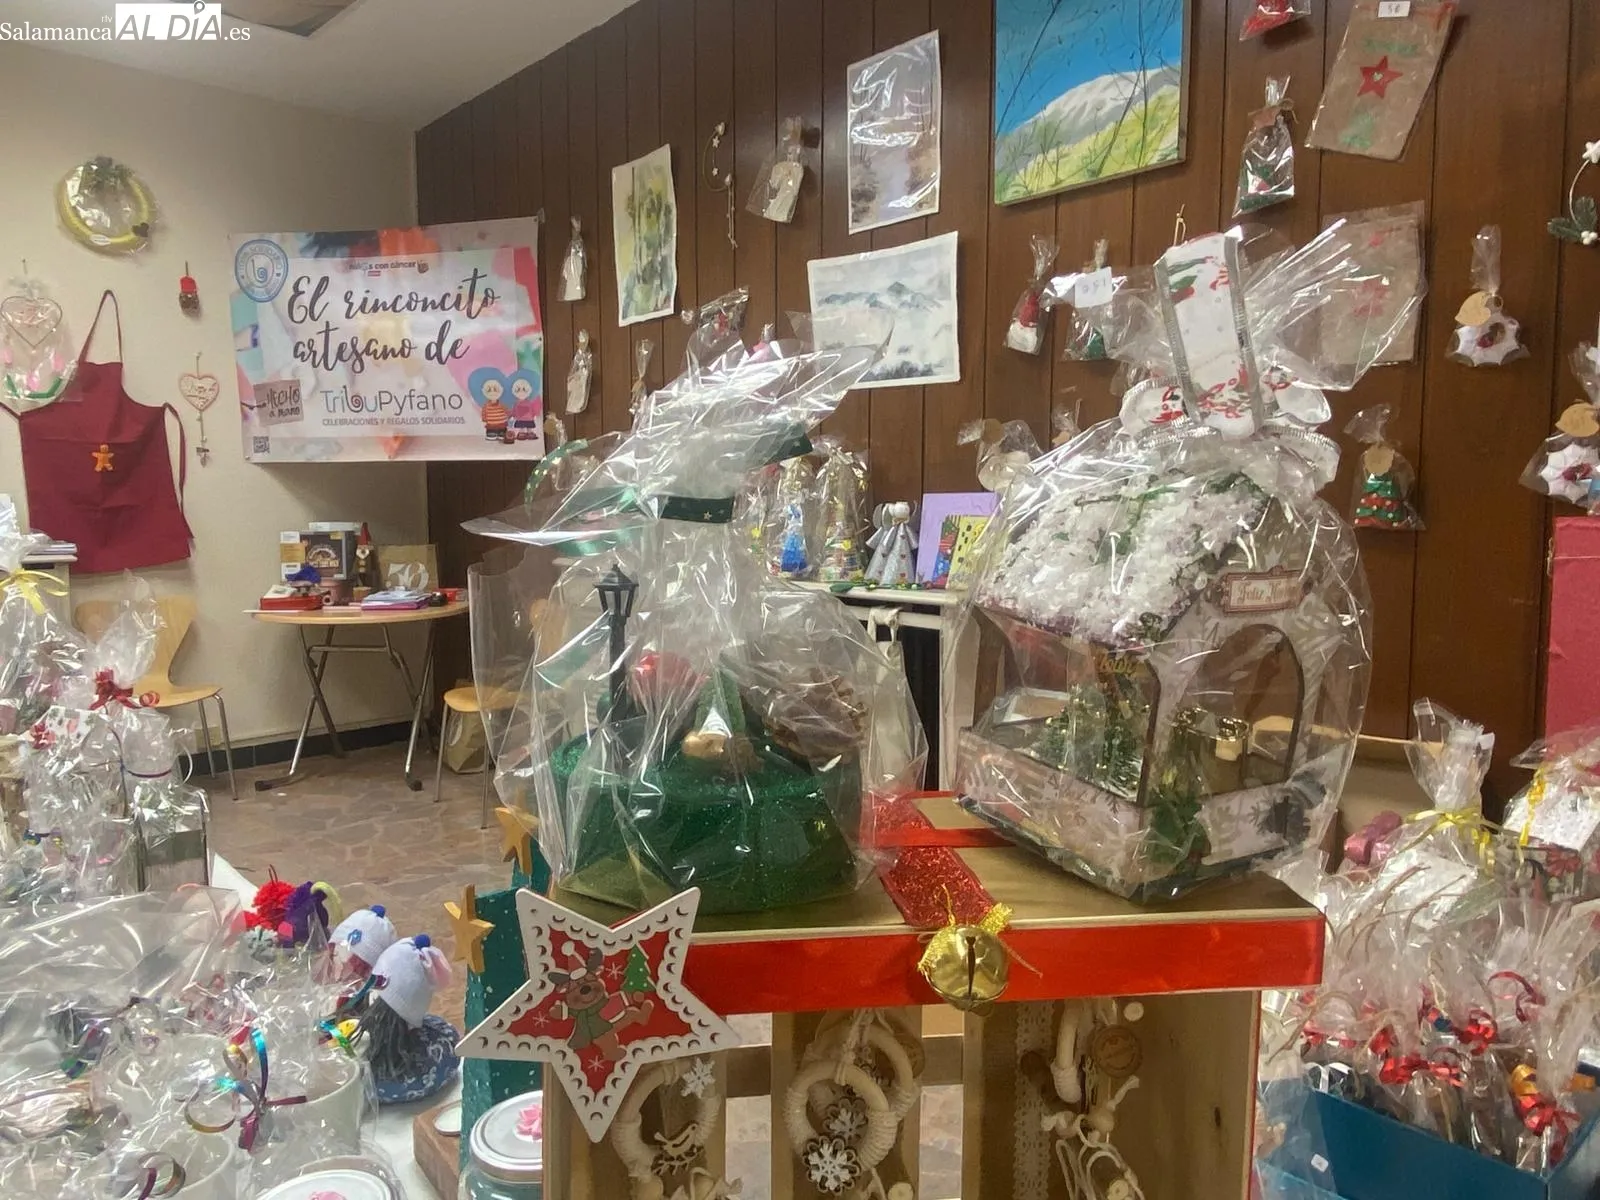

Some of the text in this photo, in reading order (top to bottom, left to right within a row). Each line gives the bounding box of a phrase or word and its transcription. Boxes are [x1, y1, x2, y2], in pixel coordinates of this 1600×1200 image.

[287, 275, 330, 324] El
[343, 267, 501, 320] rinconcito
[293, 319, 471, 374] artesano de
[266, 385, 301, 410] HECHO
[278, 406, 300, 418] mano
[319, 384, 464, 417] TribuPyfano
[322, 417, 380, 427] CELEBRACIONES
[386, 417, 420, 426] REGALOS
[420, 415, 466, 425] SOLIDARIOS
